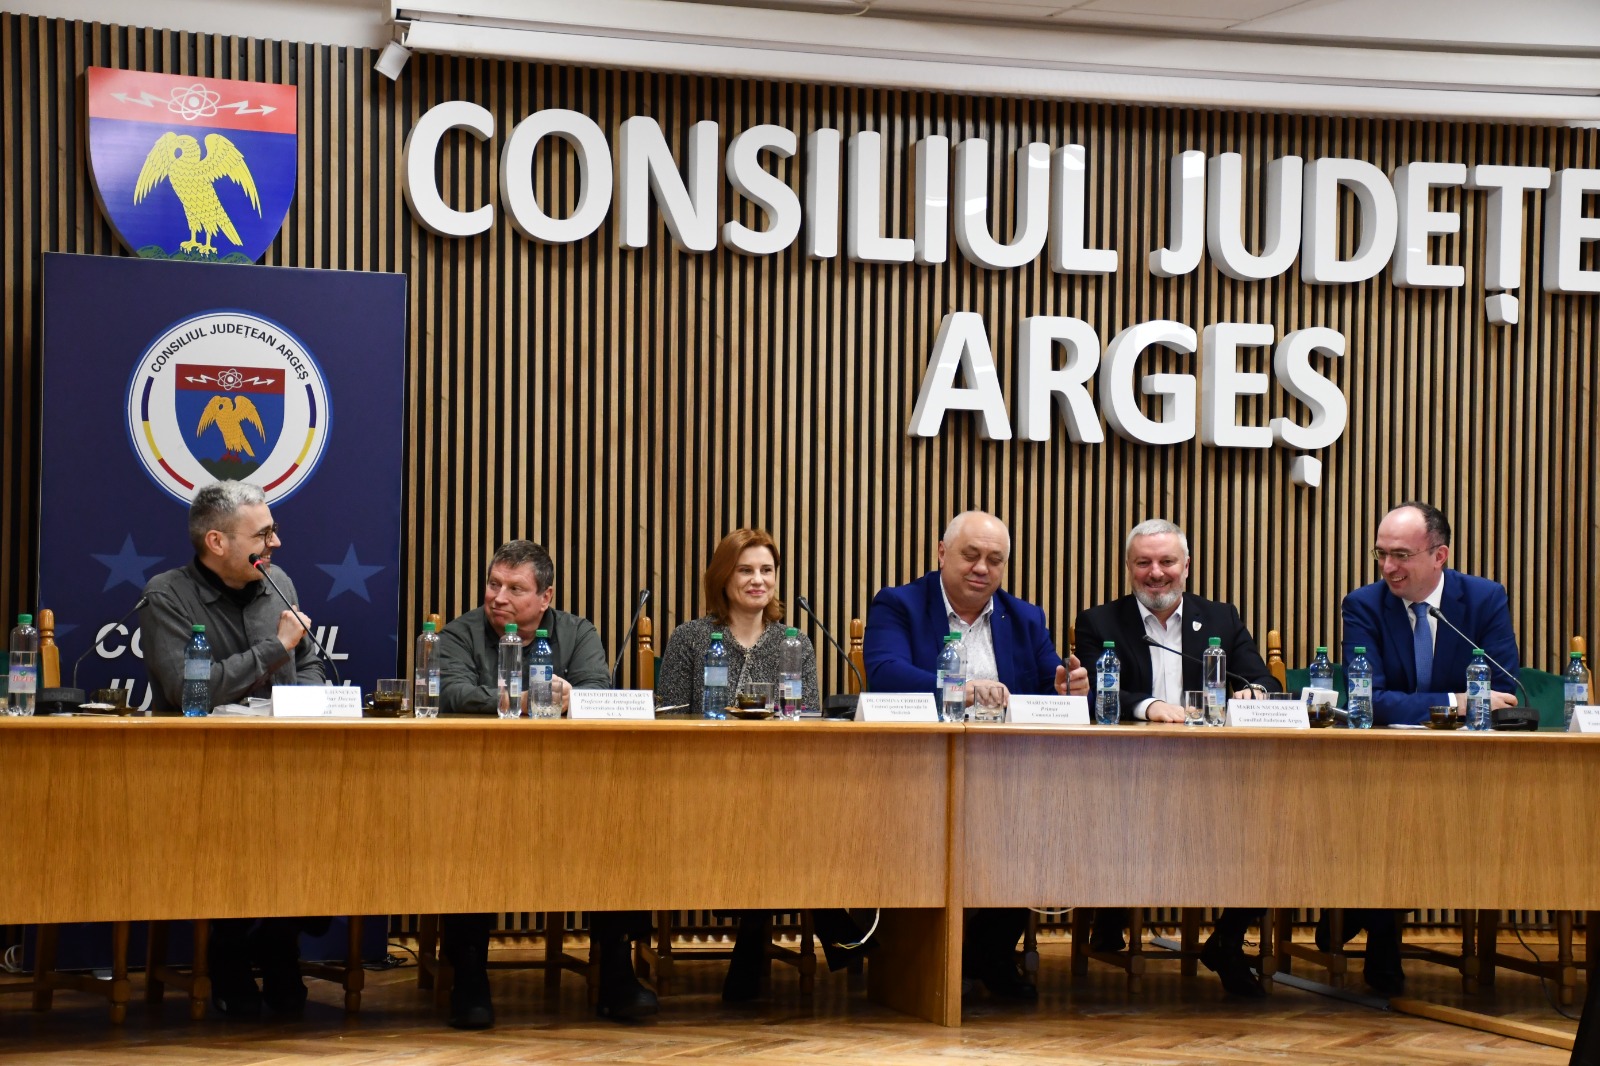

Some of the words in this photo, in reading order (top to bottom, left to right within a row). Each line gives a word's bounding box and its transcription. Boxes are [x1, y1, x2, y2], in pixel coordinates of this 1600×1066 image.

[403, 101, 1118, 276] CONSILIUL
[151, 327, 207, 373] CONSILIUL
[210, 323, 277, 347] JUDEȚEAN
[276, 343, 309, 381] ARGEȘ
[908, 312, 1347, 488] ARGEȘ
